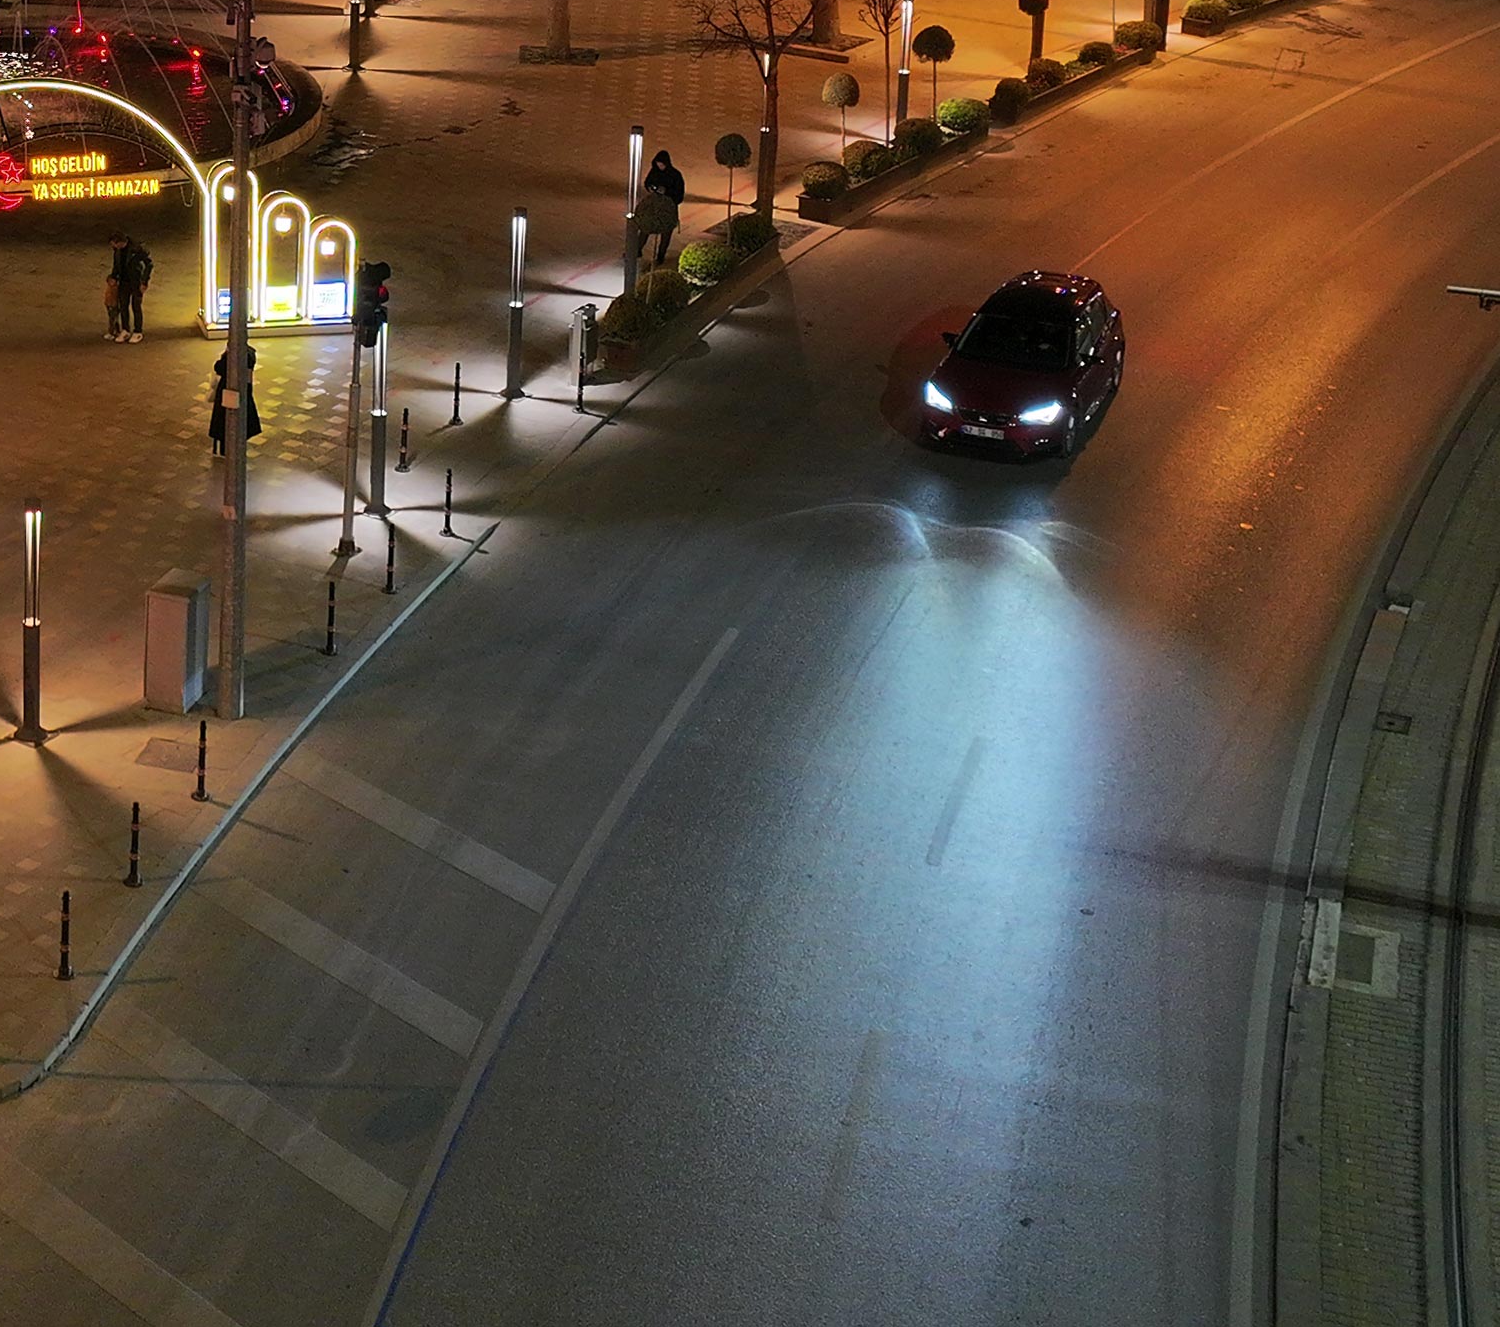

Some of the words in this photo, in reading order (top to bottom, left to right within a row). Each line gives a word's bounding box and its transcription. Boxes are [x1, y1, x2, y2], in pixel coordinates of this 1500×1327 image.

[31, 157, 58, 178] HOŞ
[59, 152, 107, 174] GELDİN
[32, 182, 49, 201] YA
[97, 179, 161, 198] RAMAZAN
